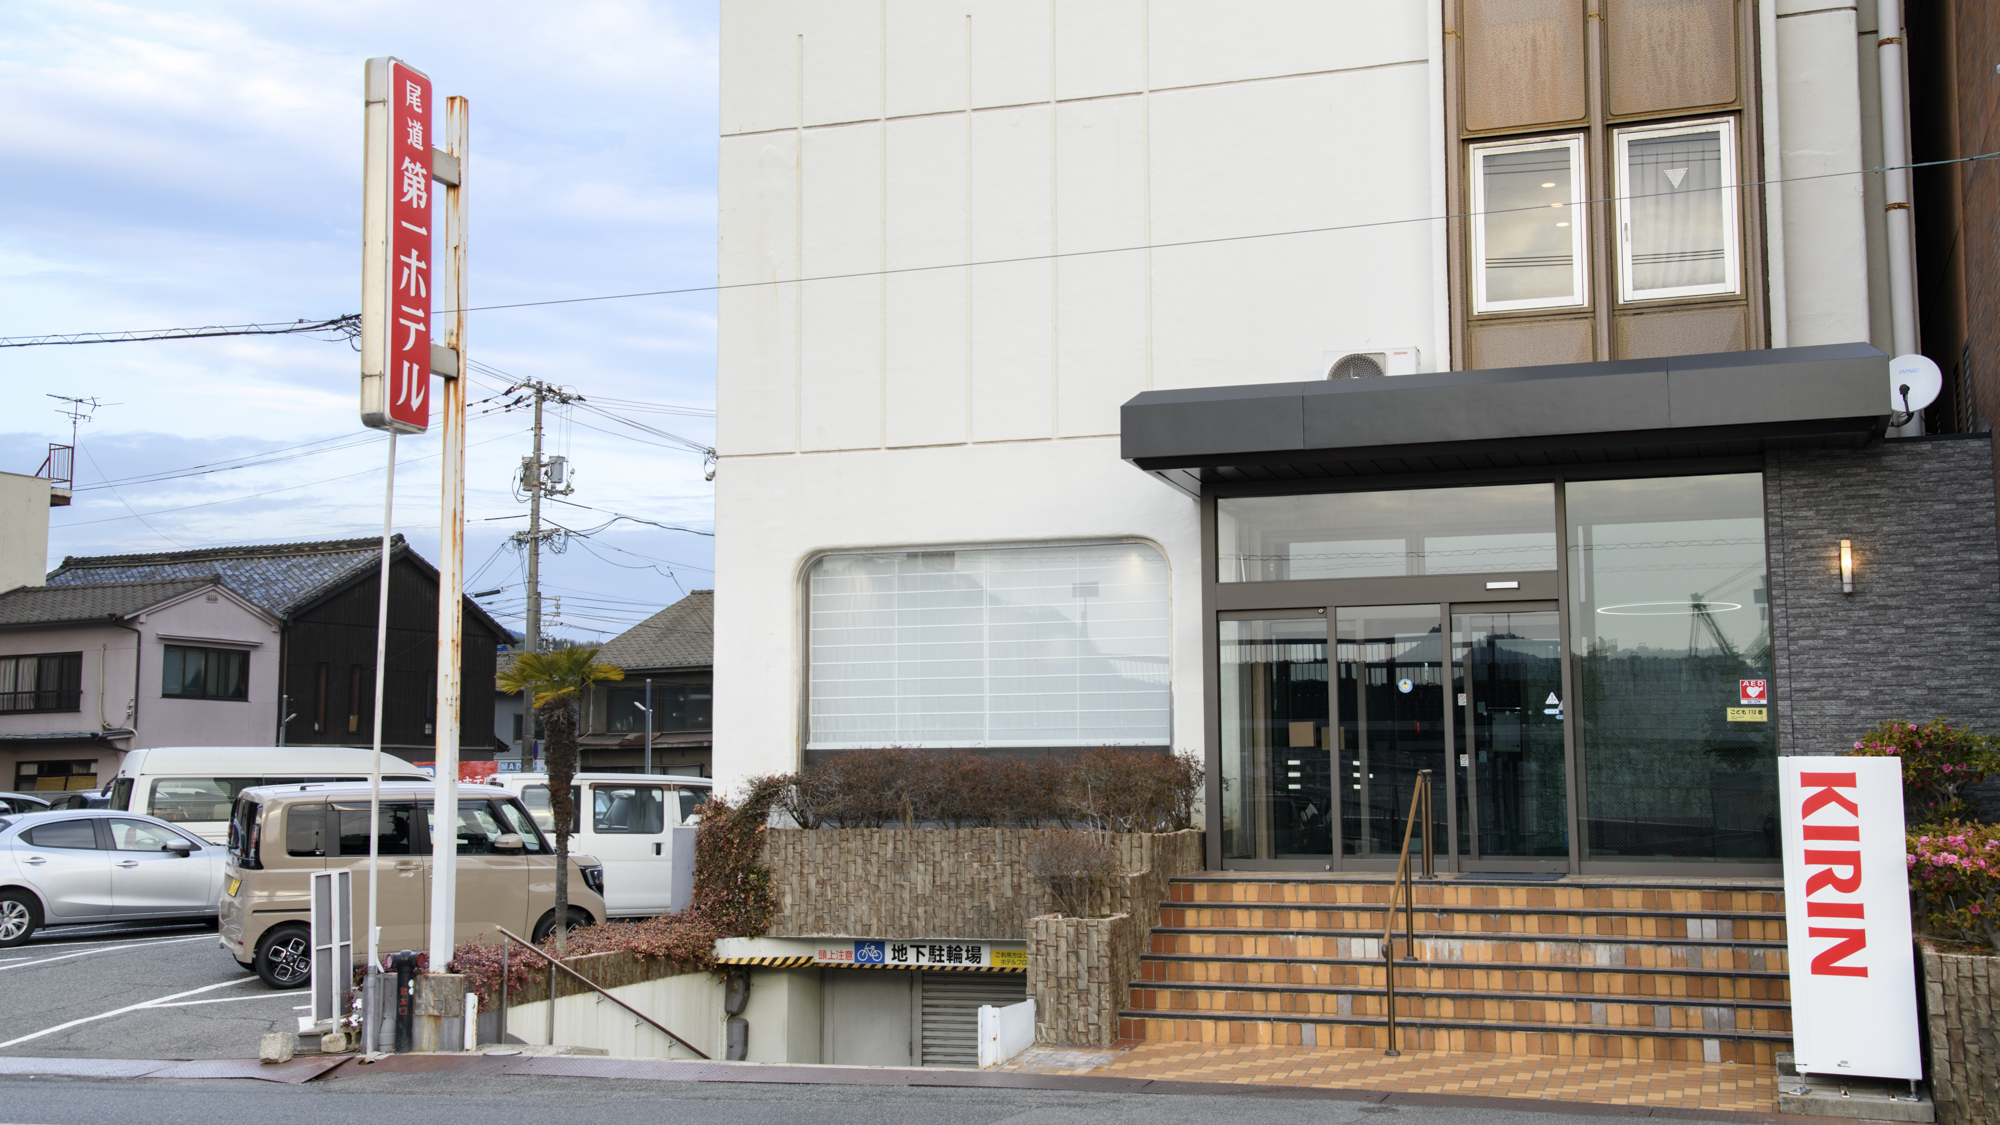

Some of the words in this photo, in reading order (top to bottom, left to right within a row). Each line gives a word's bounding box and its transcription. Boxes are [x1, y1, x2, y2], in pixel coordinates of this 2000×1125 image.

[396, 79, 428, 412] 尾道第一ホテル
[1800, 771, 1869, 978] KIRIN
[818, 949, 854, 961] 頭上注意
[891, 943, 982, 964] 地下駐輪場
